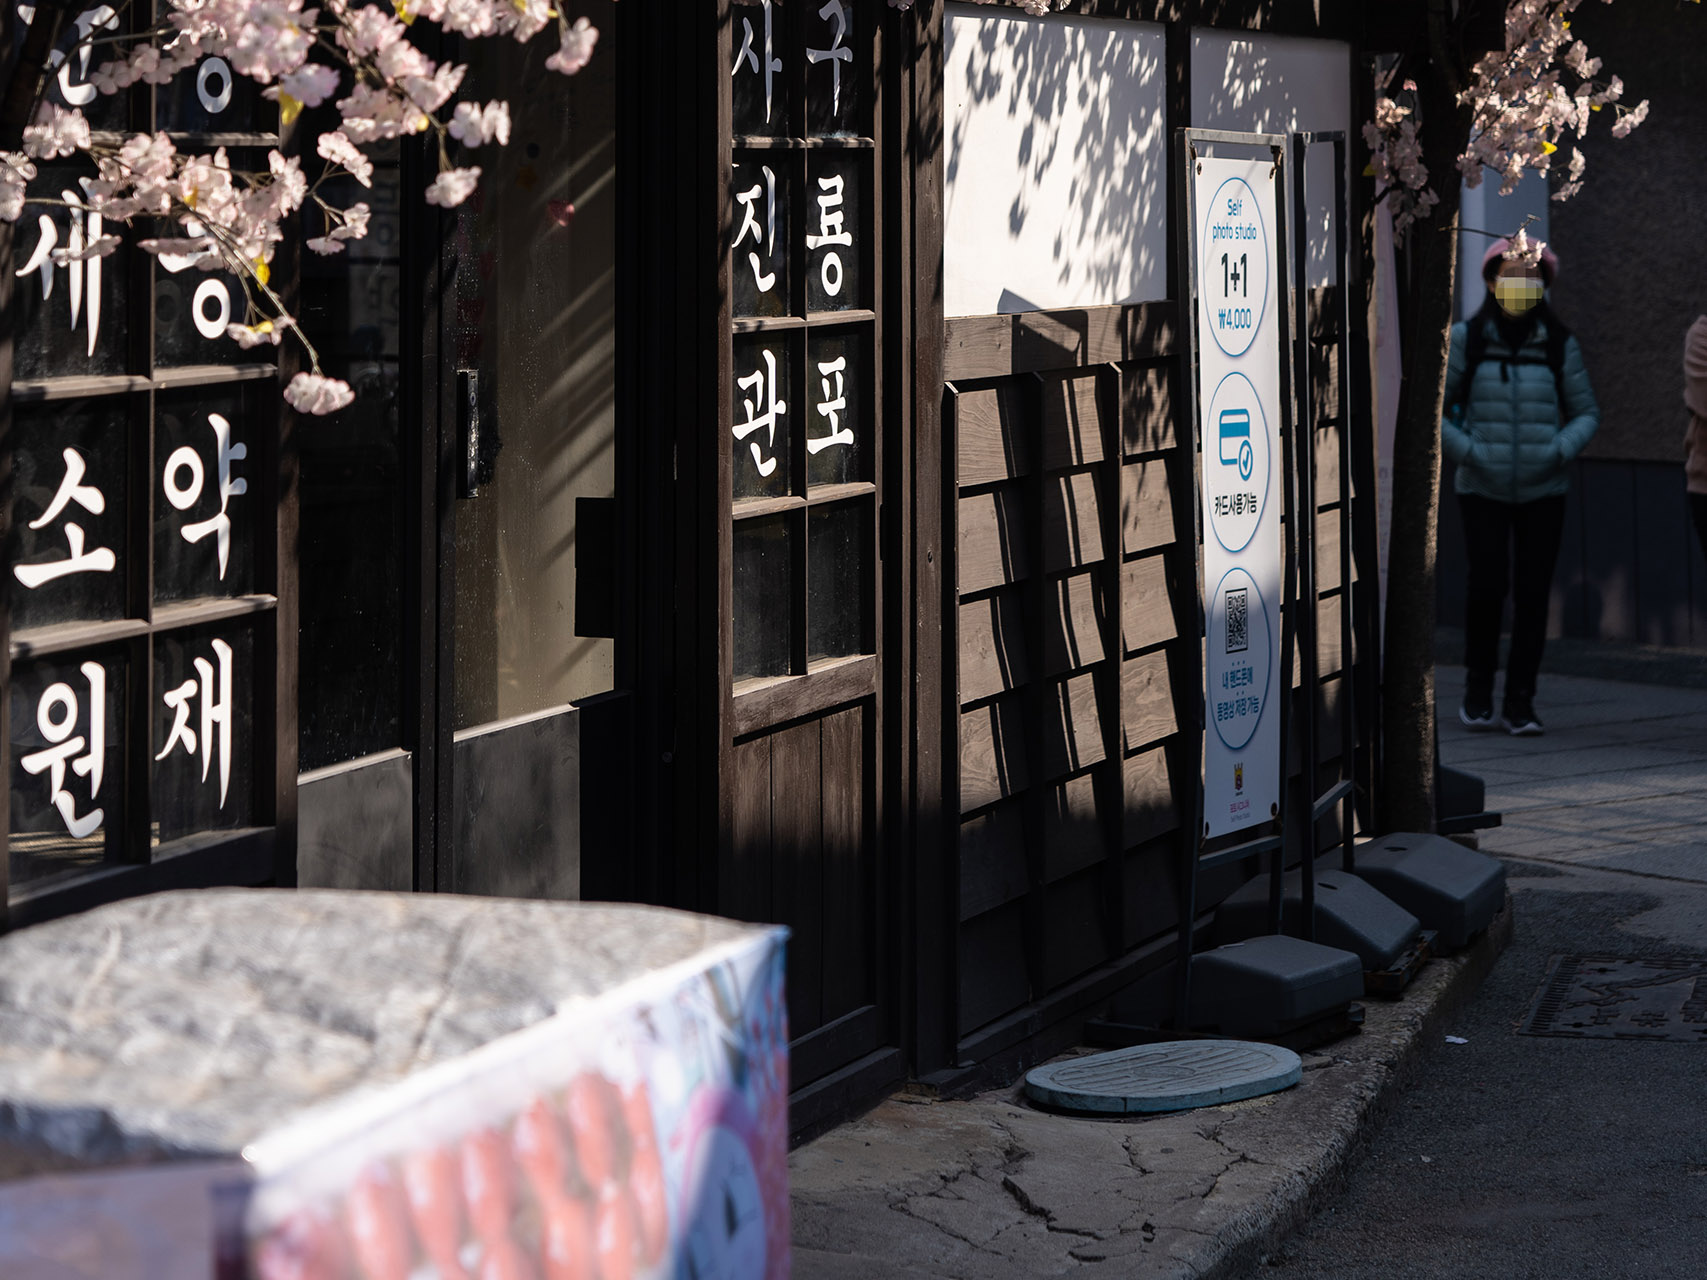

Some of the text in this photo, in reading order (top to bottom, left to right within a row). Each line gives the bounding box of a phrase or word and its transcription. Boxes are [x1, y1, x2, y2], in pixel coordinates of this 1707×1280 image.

[1227, 199, 1242, 216] Self
[1213, 222, 1257, 243] photo studio
[1221, 252, 1247, 298] 1+1
[1217, 700, 1235, 721] 동영상
